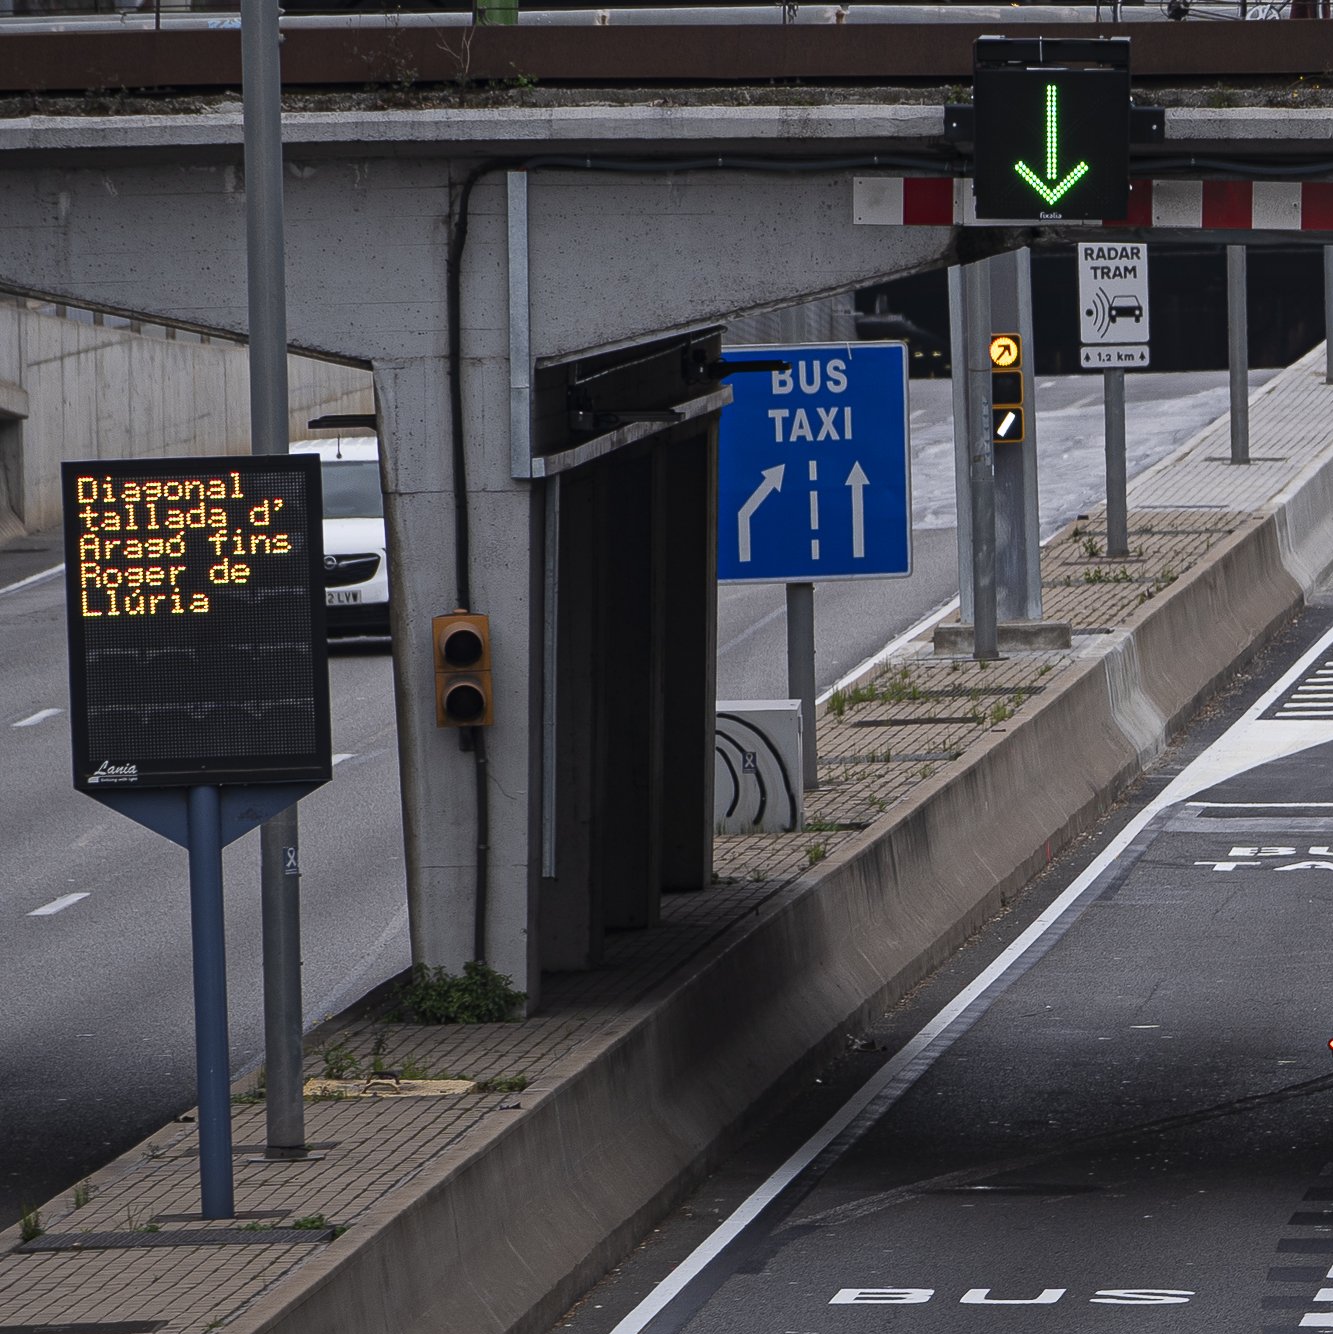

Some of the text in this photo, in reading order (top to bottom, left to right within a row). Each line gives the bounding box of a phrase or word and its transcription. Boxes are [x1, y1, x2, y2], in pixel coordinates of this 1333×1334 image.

[1084, 247, 1141, 261] RADAR
[1090, 266, 1137, 280] TRAM
[1117, 351, 1135, 362] km
[771, 358, 848, 395] BUS
[768, 406, 852, 442] TAXI
[77, 471, 244, 503] Diagonal
[78, 502, 227, 532] tallada
[79, 528, 292, 560] Aragó fins
[80, 557, 250, 588] Roger de
[82, 587, 210, 617] Llúria
[93, 760, 139, 776] Lania
[829, 1288, 1195, 1305] BUS
